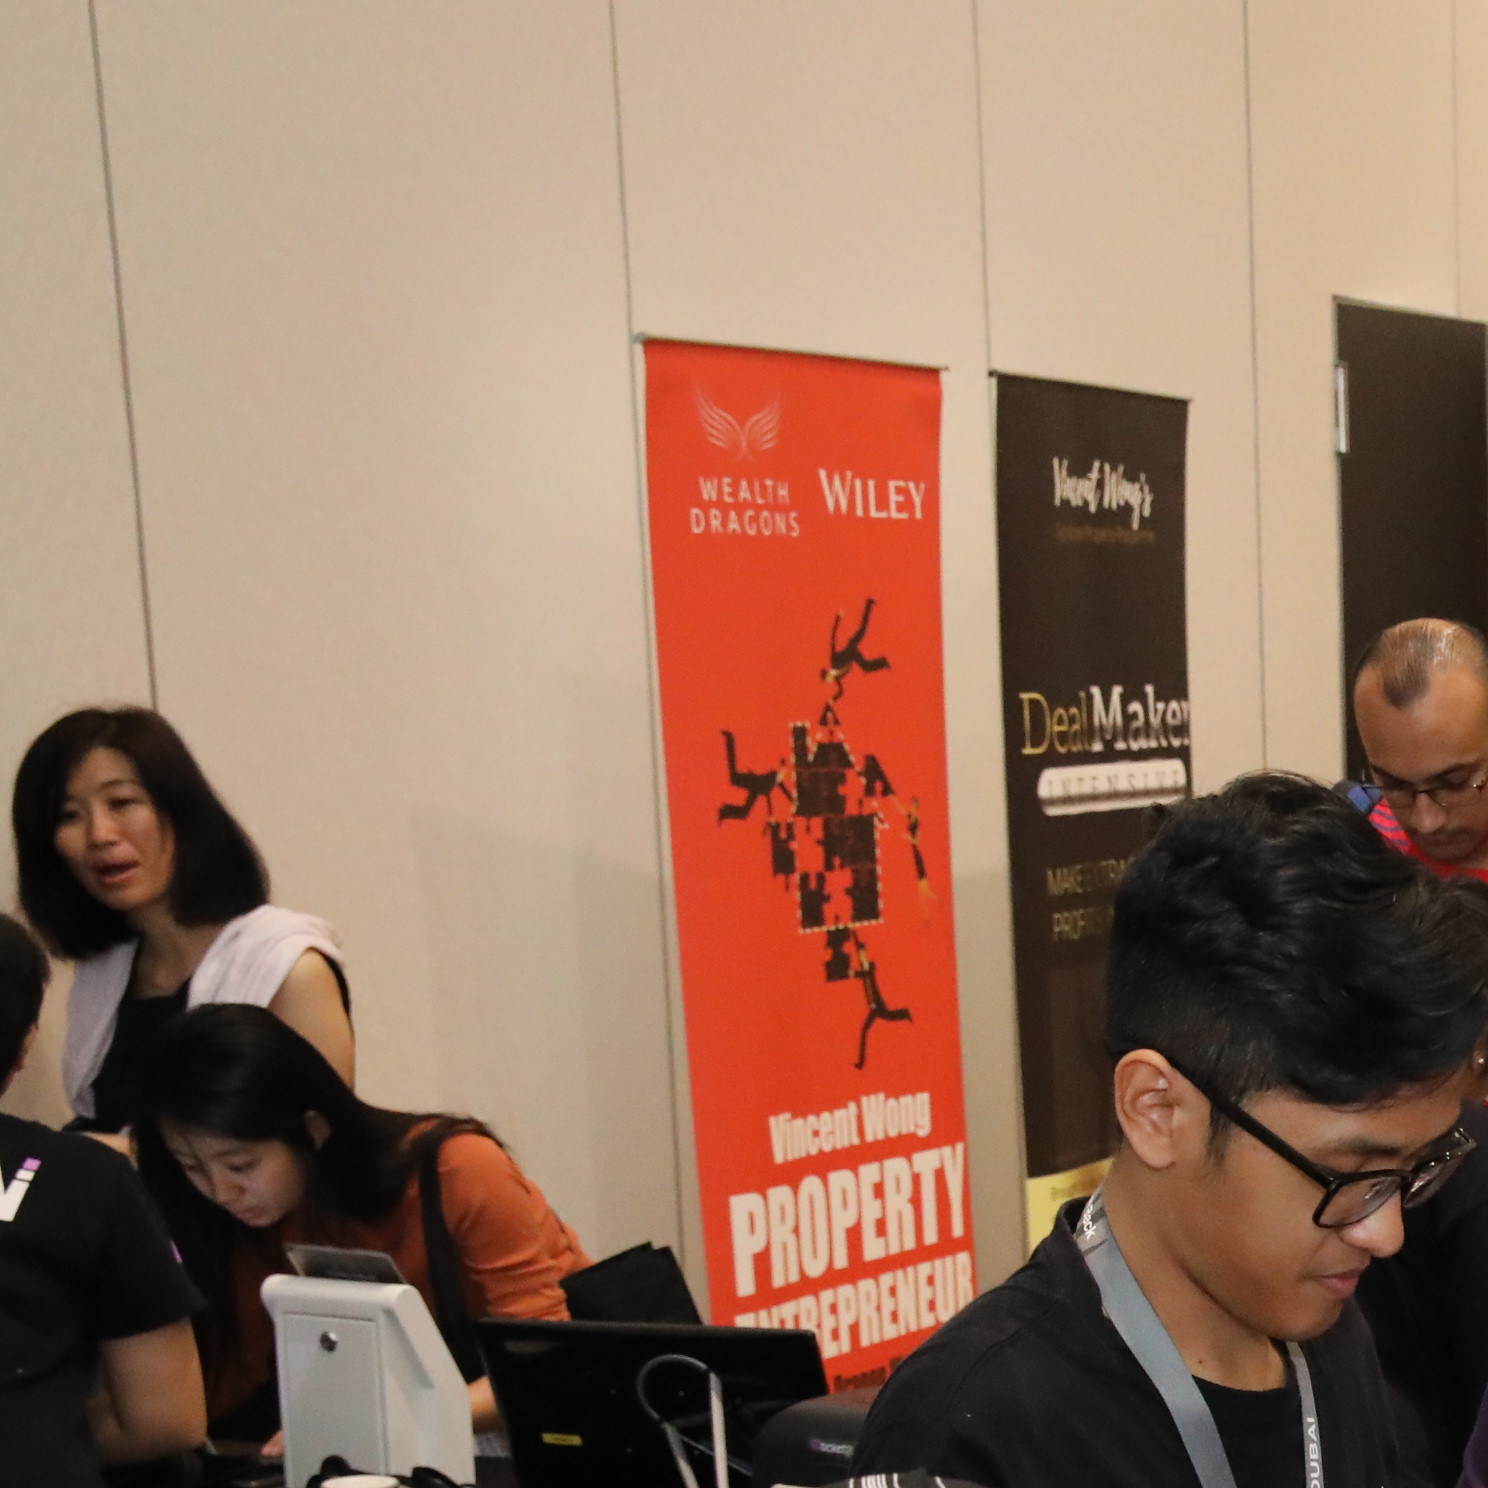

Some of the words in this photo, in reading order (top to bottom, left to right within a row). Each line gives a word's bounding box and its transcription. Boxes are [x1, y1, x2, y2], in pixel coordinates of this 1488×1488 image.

[699, 476, 791, 504] WEALTH
[817, 468, 926, 520] WILEY
[689, 507, 800, 537] DRAGONS
[769, 1101, 861, 1164] Vincent
[861, 1091, 932, 1142] Wong
[728, 1142, 966, 1298] PROPERTY
[735, 1251, 975, 1360] REPRENEUR
